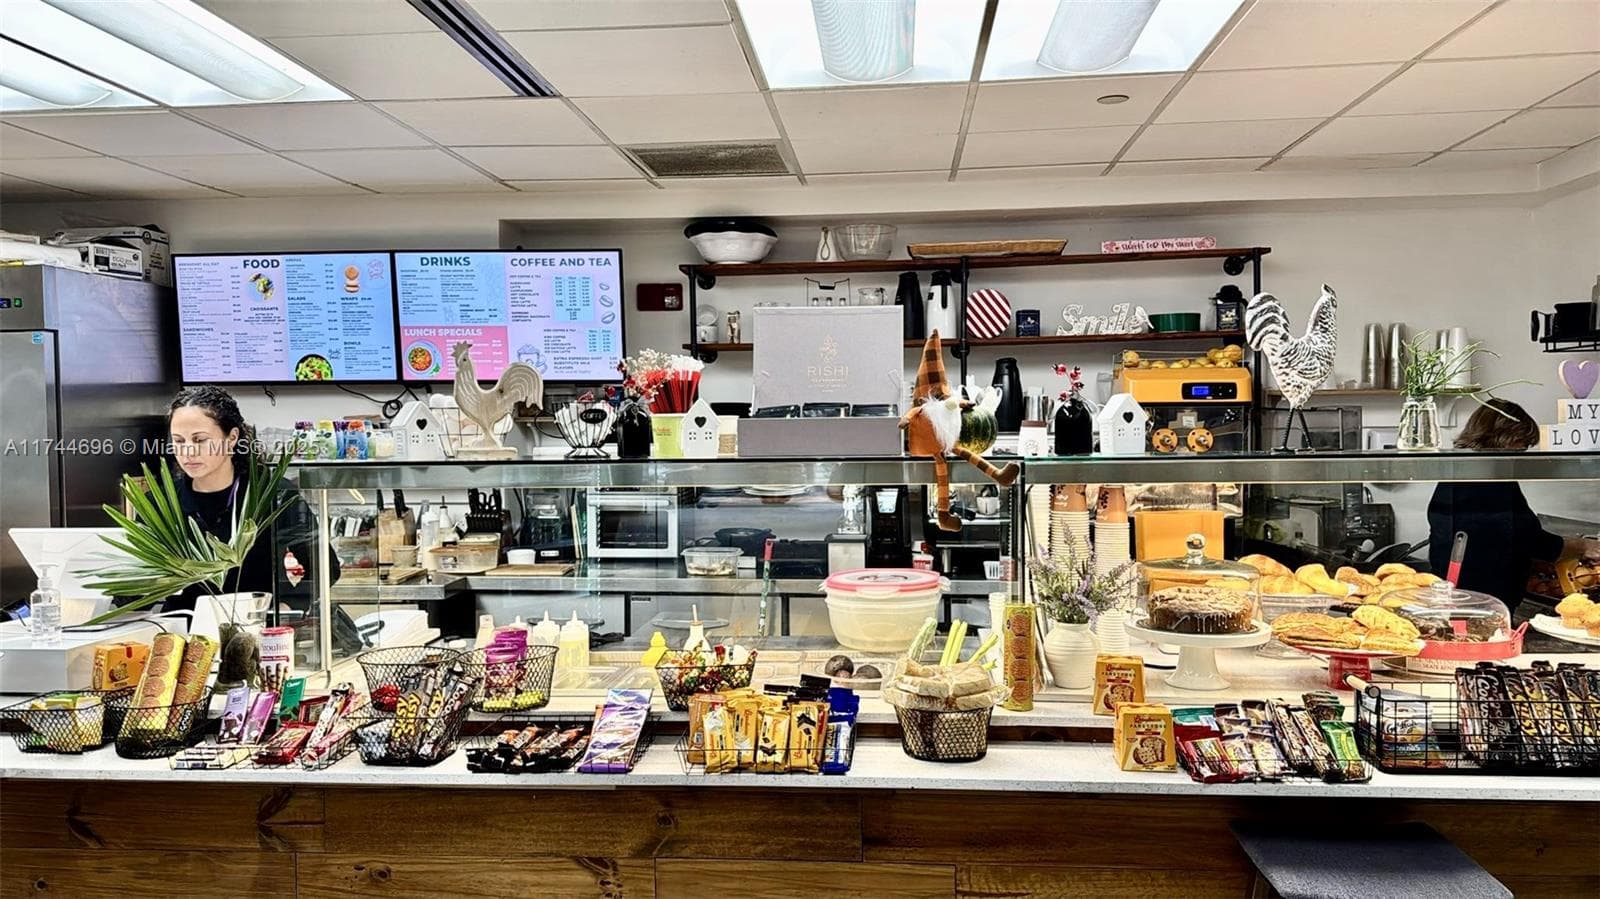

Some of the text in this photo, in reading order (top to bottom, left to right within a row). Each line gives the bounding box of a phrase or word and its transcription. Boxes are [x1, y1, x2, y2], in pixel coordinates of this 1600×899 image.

[243, 259, 280, 269] FOOD
[420, 256, 471, 267] DRINKS
[511, 257, 612, 267] COFFEE AND TEA
[1056, 303, 1148, 336] Smile
[404, 328, 483, 337] LUNCH SPECIALS
[808, 366, 849, 377] RISHI
[1568, 404, 1600, 419] MY
